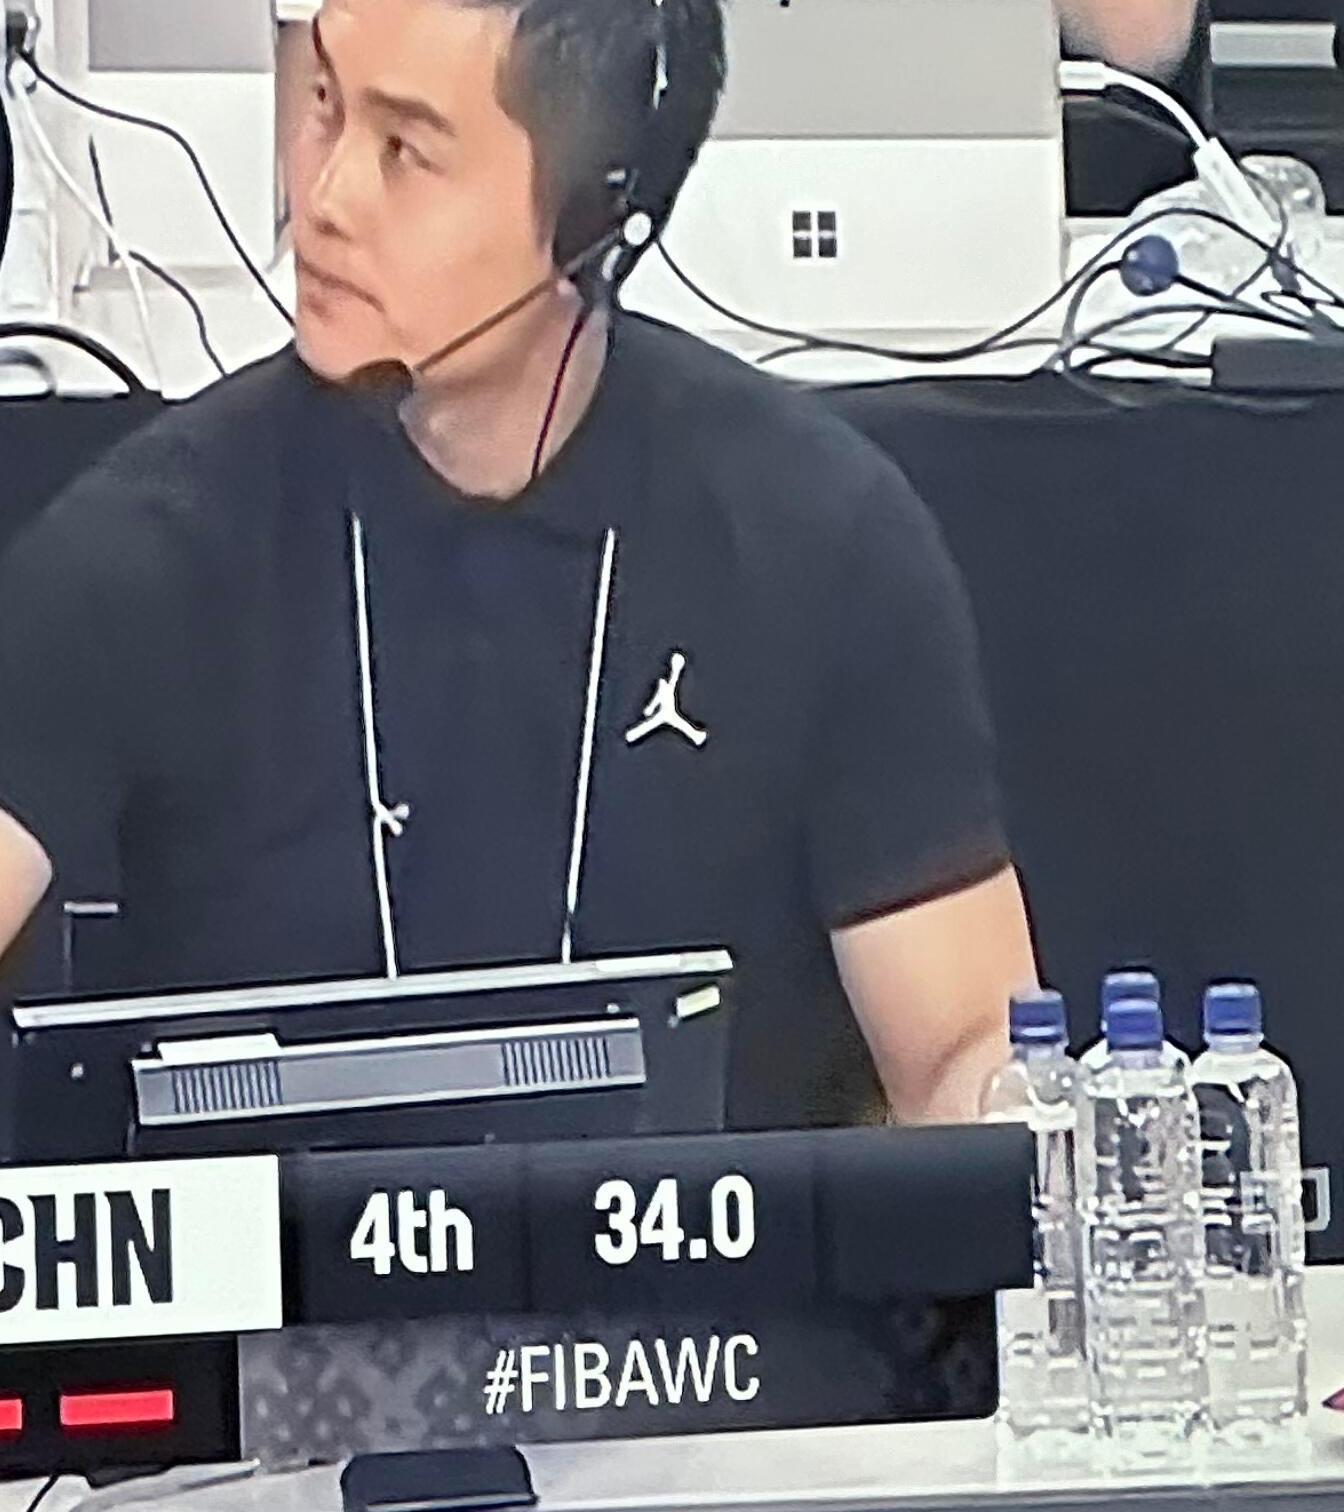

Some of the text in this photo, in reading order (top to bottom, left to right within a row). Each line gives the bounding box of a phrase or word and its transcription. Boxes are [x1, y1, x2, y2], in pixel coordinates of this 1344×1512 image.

[349, 1188, 475, 1276] 4th
[593, 1174, 756, 1265] 34.0
[481, 1333, 762, 1417] #FIBAWC
